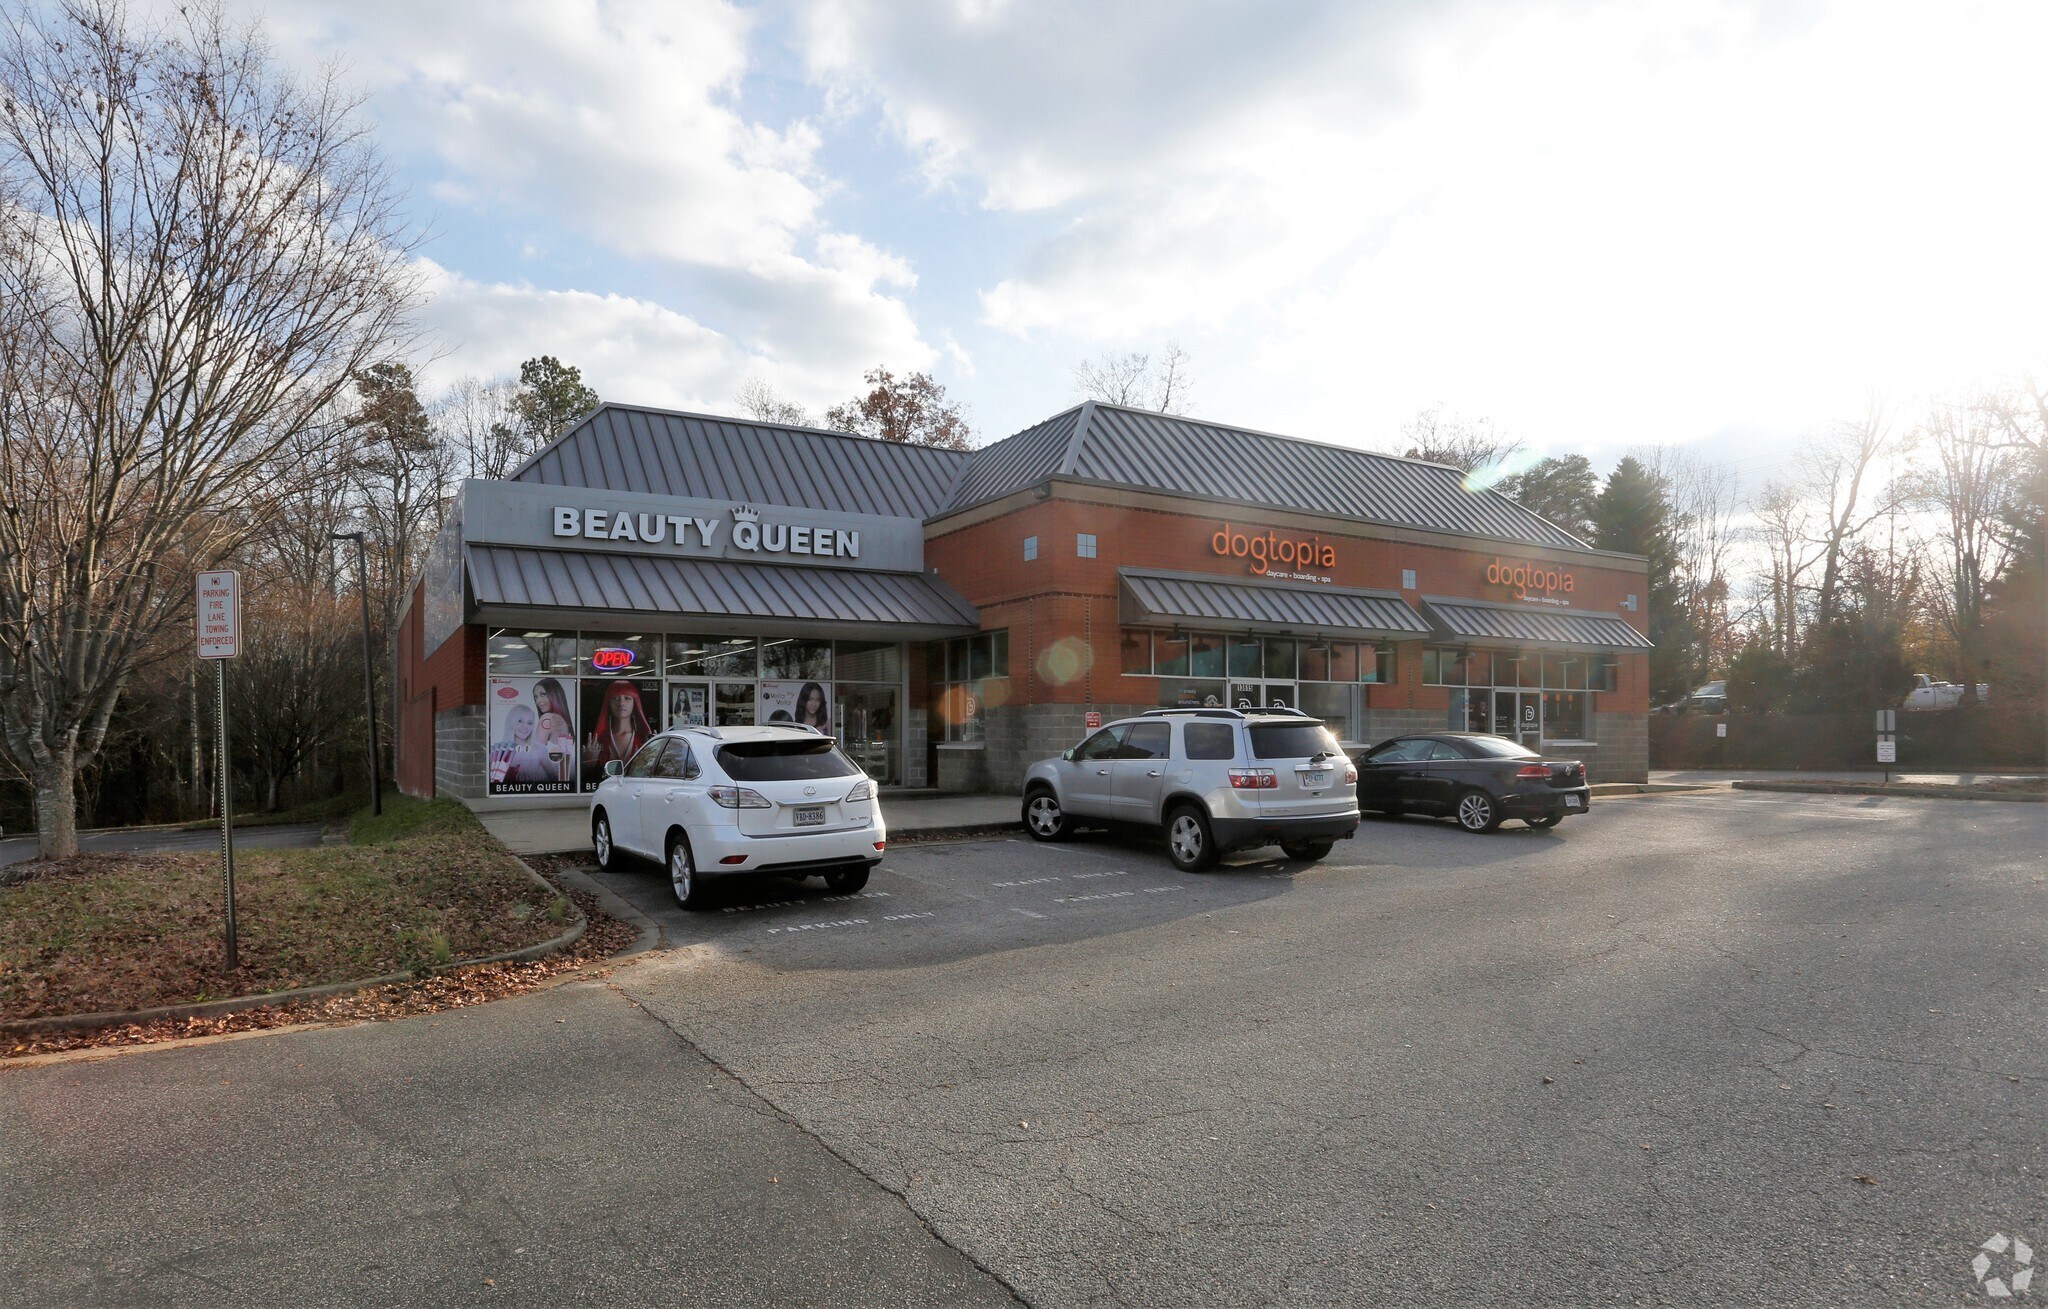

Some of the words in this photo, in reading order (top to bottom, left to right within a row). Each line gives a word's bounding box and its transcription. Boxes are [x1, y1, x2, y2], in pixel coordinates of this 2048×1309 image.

[553, 506, 720, 547] BEAUTY
[732, 521, 860, 558] QUEEN
[1212, 522, 1335, 575] dogtopia
[211, 577, 220, 586] NO
[1266, 570, 1288, 579] daycare
[1293, 572, 1317, 582] boarding
[1321, 576, 1331, 584] spa
[1487, 556, 1574, 600] dogtopia
[203, 589, 229, 597] PARKING
[209, 601, 223, 609] FIRE
[208, 613, 225, 621] LANE
[206, 625, 228, 633] TOWING
[201, 636, 233, 645] ENFORCED
[594, 651, 631, 667] OPEN
[697, 657, 728, 667] 13617
[496, 783, 533, 792] BEAUTY
[537, 783, 570, 791] QUEEN
[723, 899, 806, 913] BEAUTY
[823, 892, 891, 902] QUEEN
[767, 919, 869, 934] PARKING
[883, 911, 936, 922] ONLY
